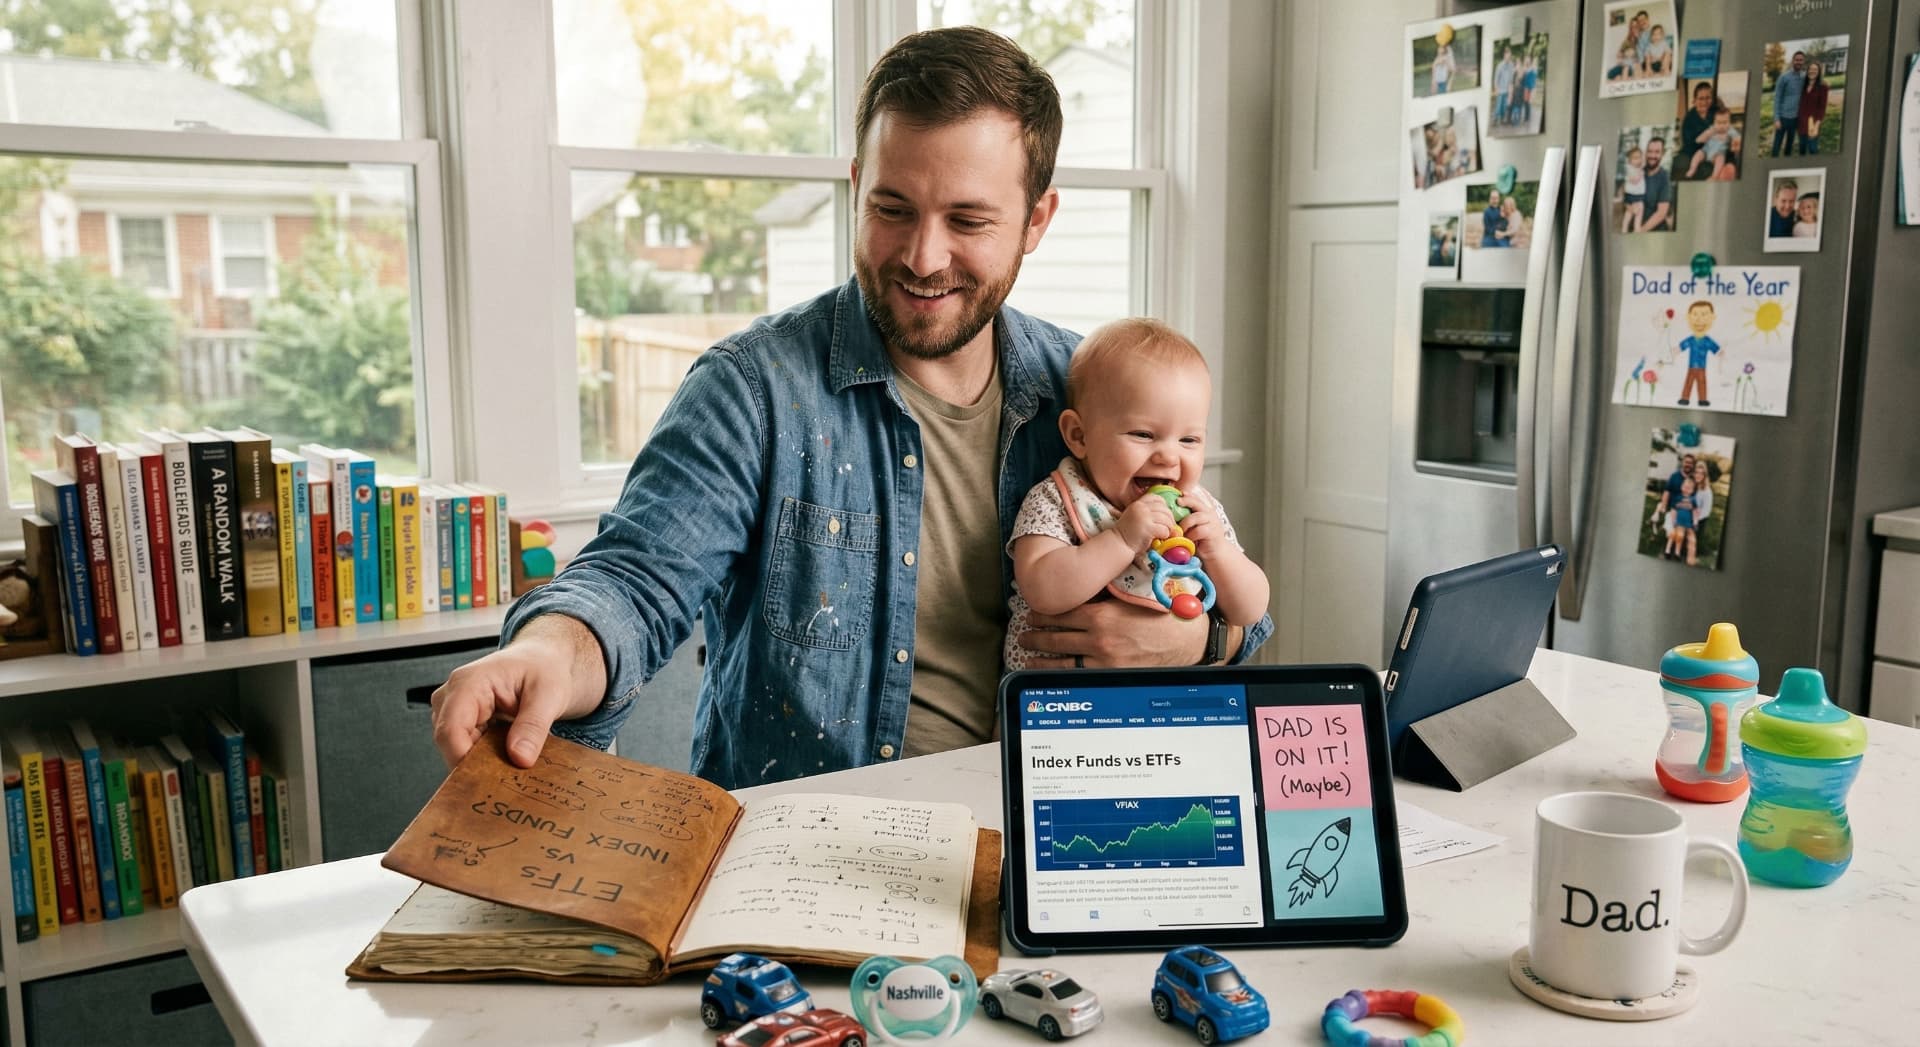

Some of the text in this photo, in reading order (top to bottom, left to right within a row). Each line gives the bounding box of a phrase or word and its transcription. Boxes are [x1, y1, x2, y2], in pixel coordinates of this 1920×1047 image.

[1632, 271, 1790, 296] Dad of the Year
[211, 467, 227, 481] A
[213, 483, 231, 555] RANDOM
[90, 538, 106, 562] GUIDE
[179, 540, 195, 576] GUIDE
[218, 557, 235, 604] WALK
[1045, 701, 1093, 712] CNBC
[1263, 716, 1313, 739] DAD
[1324, 715, 1348, 736] IS
[1031, 753, 1182, 769] Index Funds vs ETFs
[1274, 741, 1350, 768] ON IT!
[1280, 772, 1352, 800] (Maybe)
[1115, 800, 1139, 809] VFIAX
[471, 794, 670, 865] INDEX FUNDS?
[519, 865, 624, 903] ETFs
[1560, 883, 1670, 933] Dad.
[885, 983, 945, 1001] Nashville
